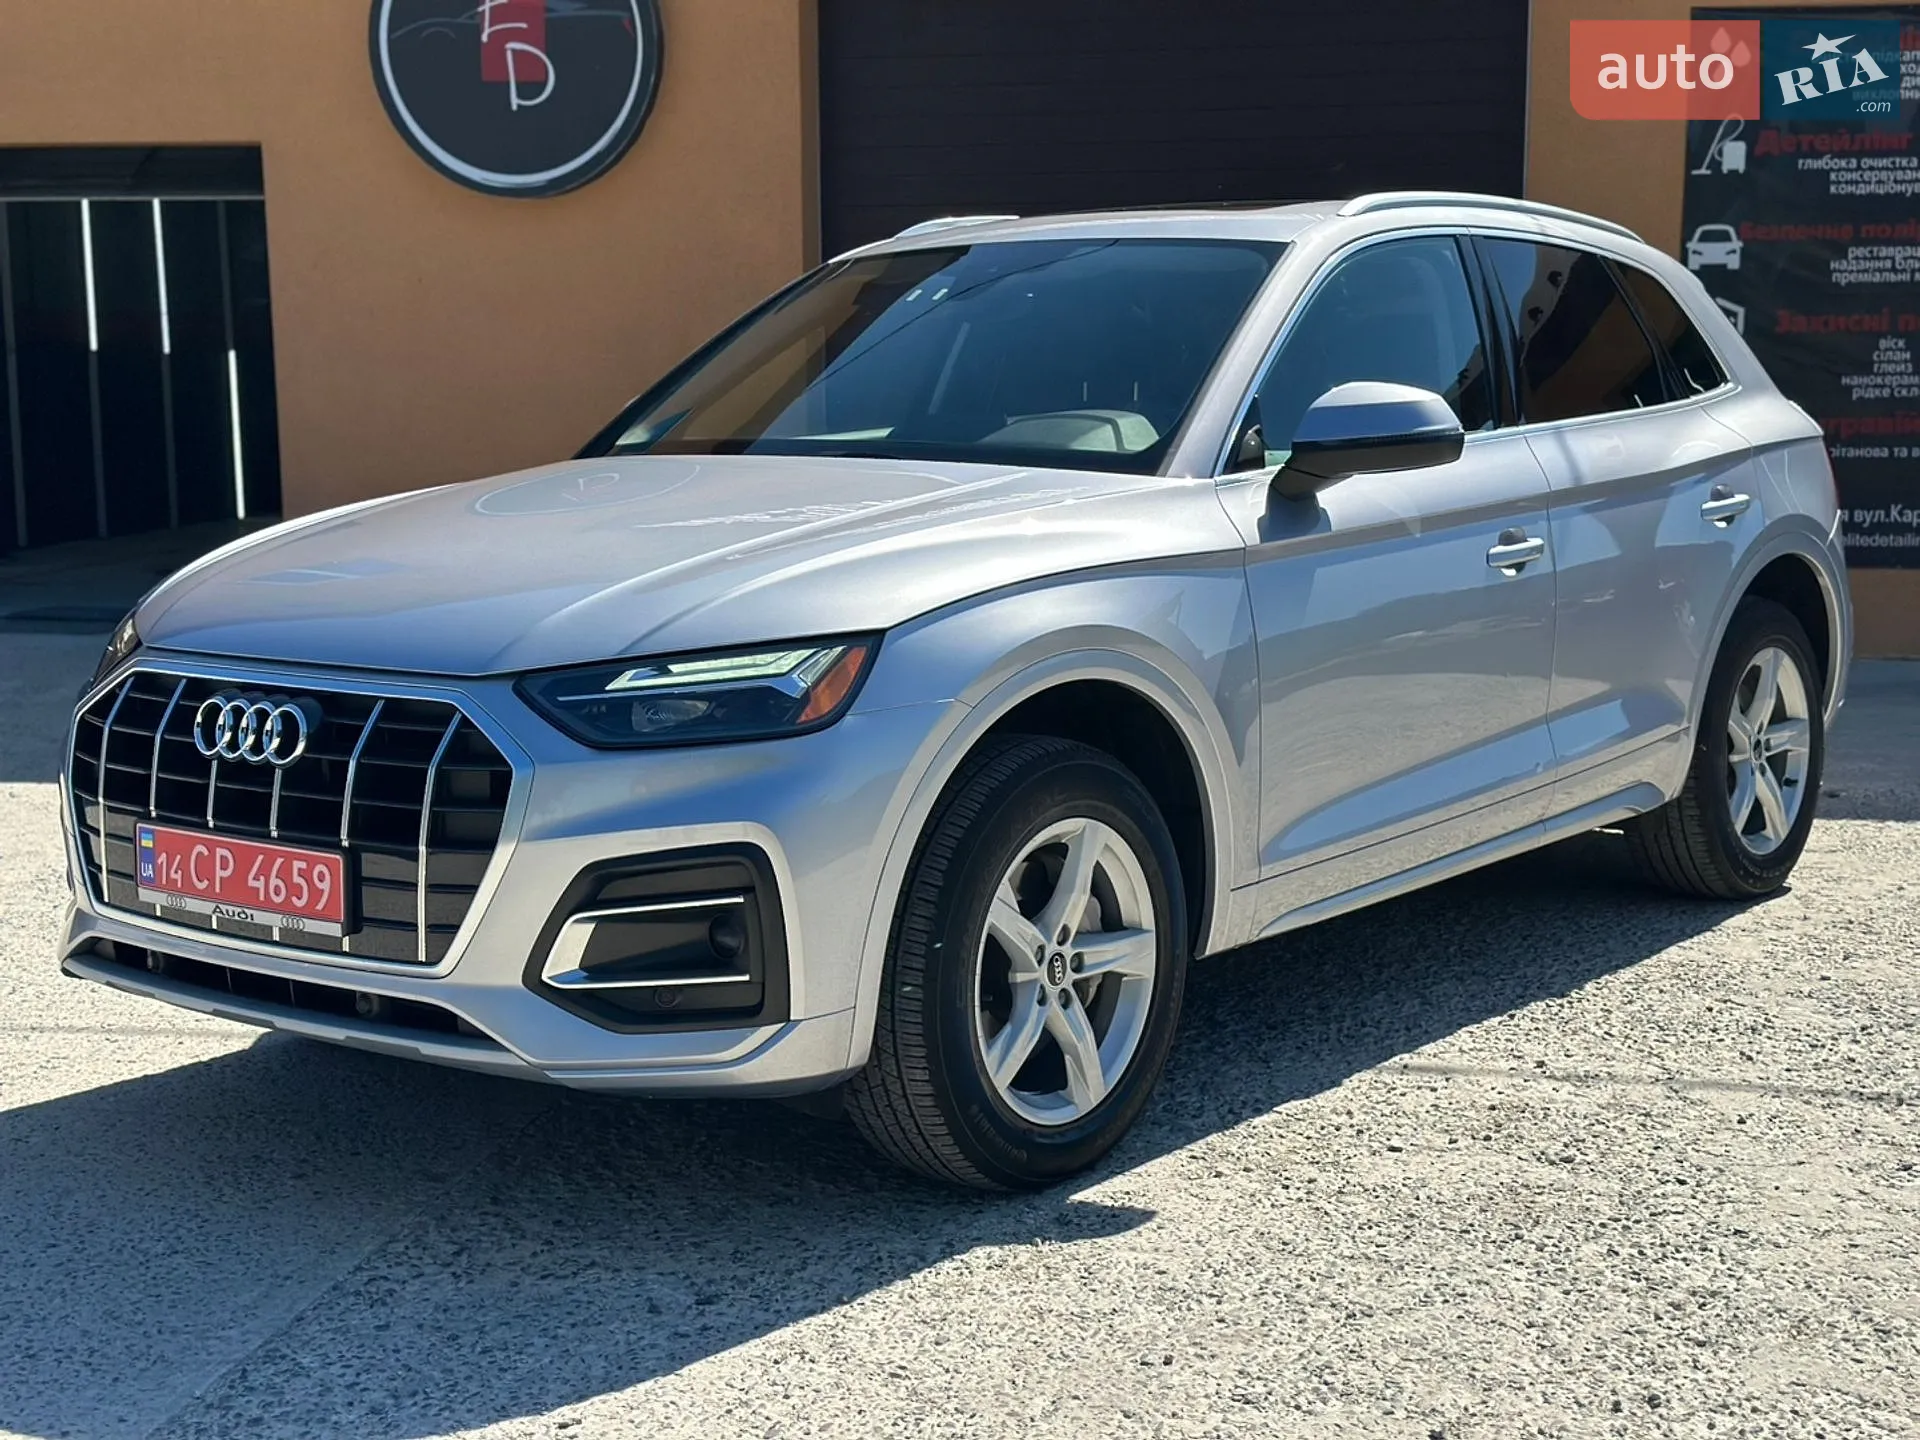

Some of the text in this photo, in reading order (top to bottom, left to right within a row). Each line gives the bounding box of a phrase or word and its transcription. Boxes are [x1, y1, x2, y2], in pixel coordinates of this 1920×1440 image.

[1798, 154, 1918, 169] глибока очистка
[1830, 259, 1892, 272] надання
[1832, 271, 1911, 287] преміальні
[1878, 336, 1906, 350] віск
[1872, 350, 1911, 361] сілан
[1852, 386, 1891, 401] рідке
[1893, 447, 1908, 457] та
[141, 861, 154, 879] UA
[247, 853, 332, 911] 4659
[212, 904, 255, 921] Audi
